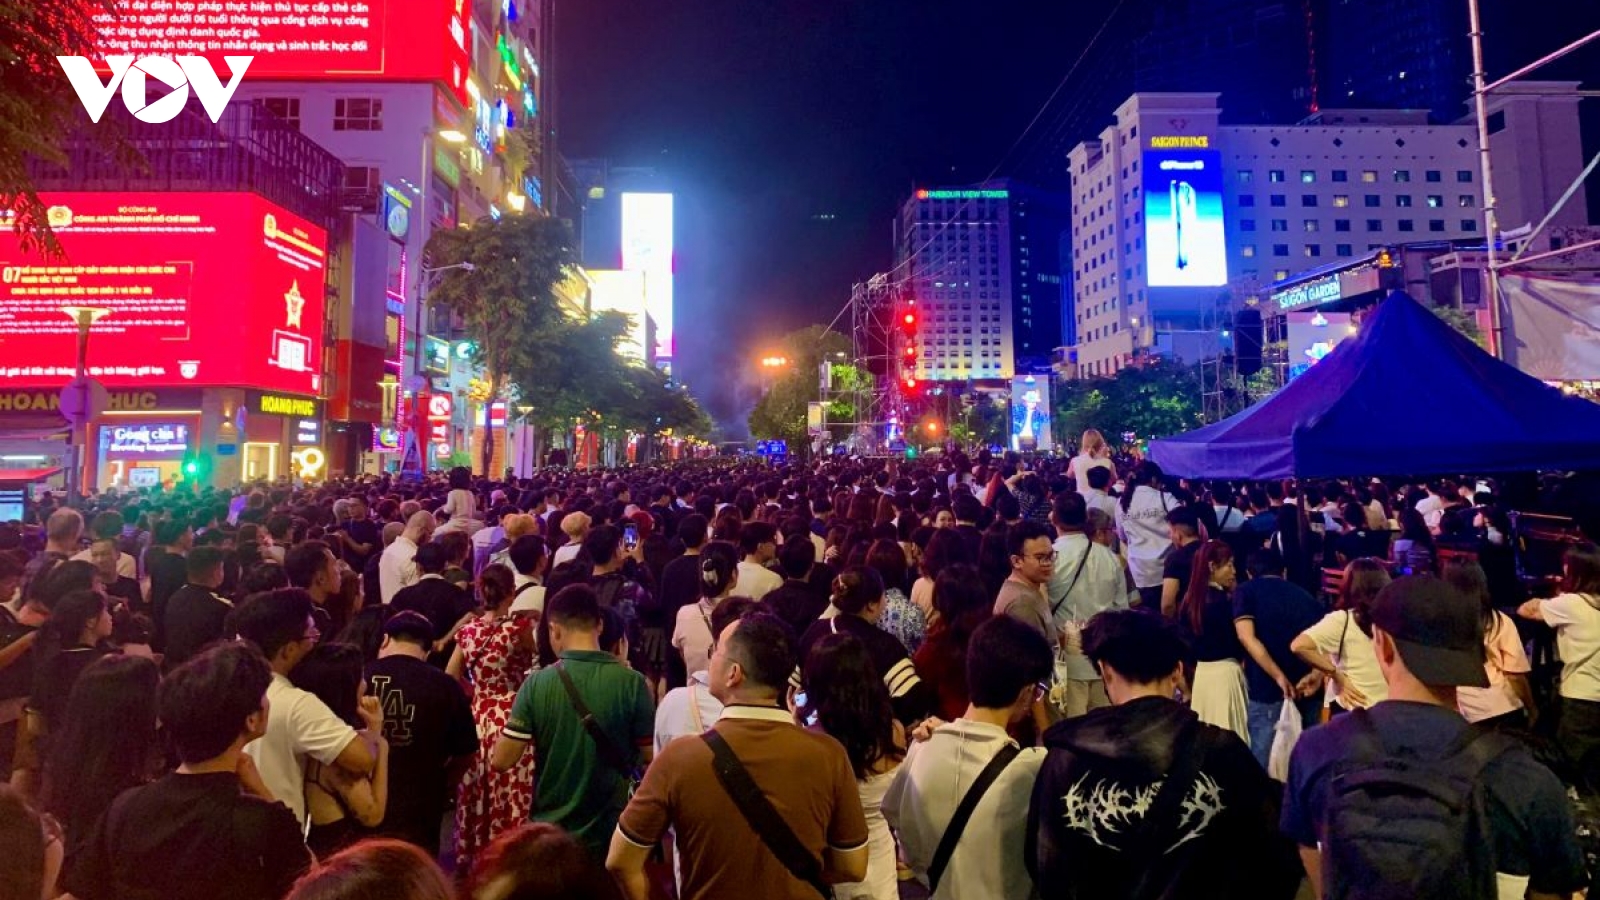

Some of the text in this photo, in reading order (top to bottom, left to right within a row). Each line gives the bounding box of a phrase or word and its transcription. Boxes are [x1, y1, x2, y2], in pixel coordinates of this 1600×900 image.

[194, 14, 206, 24] 06
[261, 14, 280, 26] qua
[190, 26, 215, 37] danh
[131, 39, 148, 50] thu
[288, 40, 309, 51] sinh
[1151, 135, 1208, 148] SAIGON PRINCE
[927, 190, 1008, 199] HARBOUR VIEW TOWER
[2, 266, 21, 283] 07
[1279, 287, 1307, 308] SAIGON
[1308, 281, 1340, 300] GARDEN
[0, 392, 156, 410] HOAN HUC
[261, 396, 314, 416] HOANG PHUC
[371, 675, 415, 739] LA
